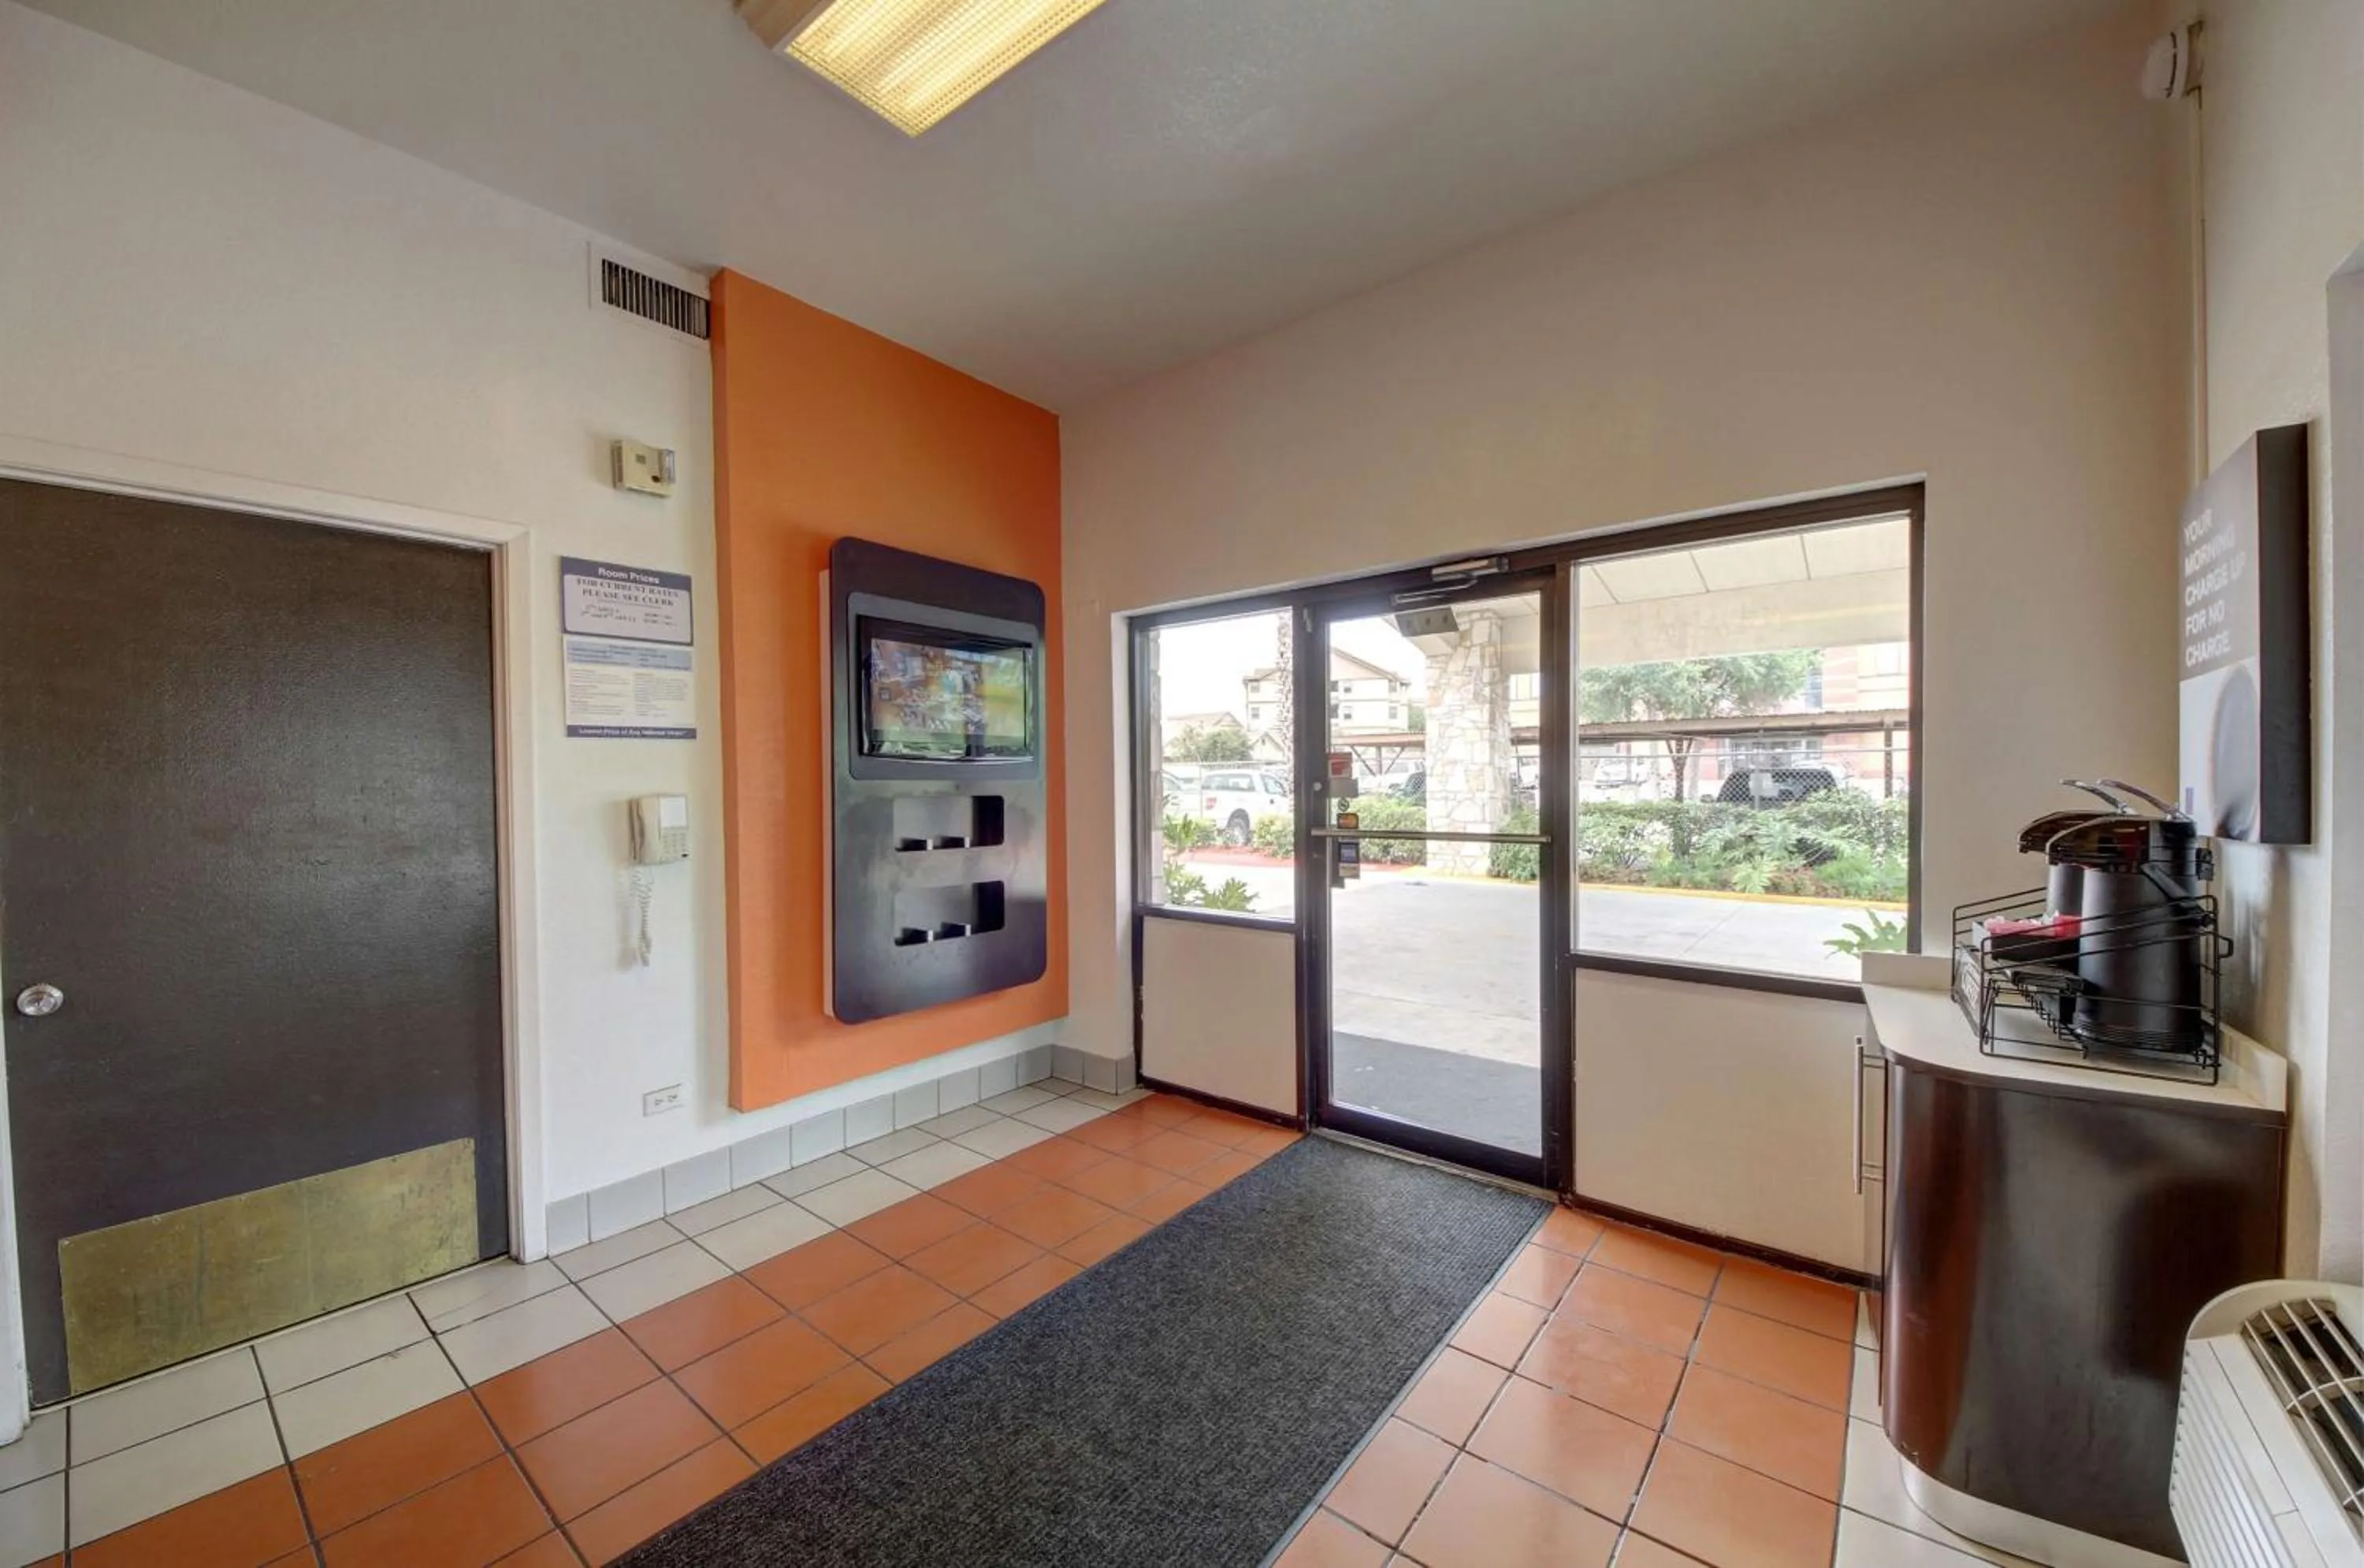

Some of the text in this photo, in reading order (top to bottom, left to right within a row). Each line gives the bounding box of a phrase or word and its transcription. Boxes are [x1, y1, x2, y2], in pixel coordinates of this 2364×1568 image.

[2184, 508, 2213, 545] YOUR
[2184, 522, 2236, 577] MORNING
[582, 589, 618, 600] PLEASE
[598, 567, 660, 585] Room Prices
[2185, 551, 2246, 607] CHARGE UP
[2185, 600, 2226, 638] FOR NO
[2185, 630, 2232, 667] CHARGE
